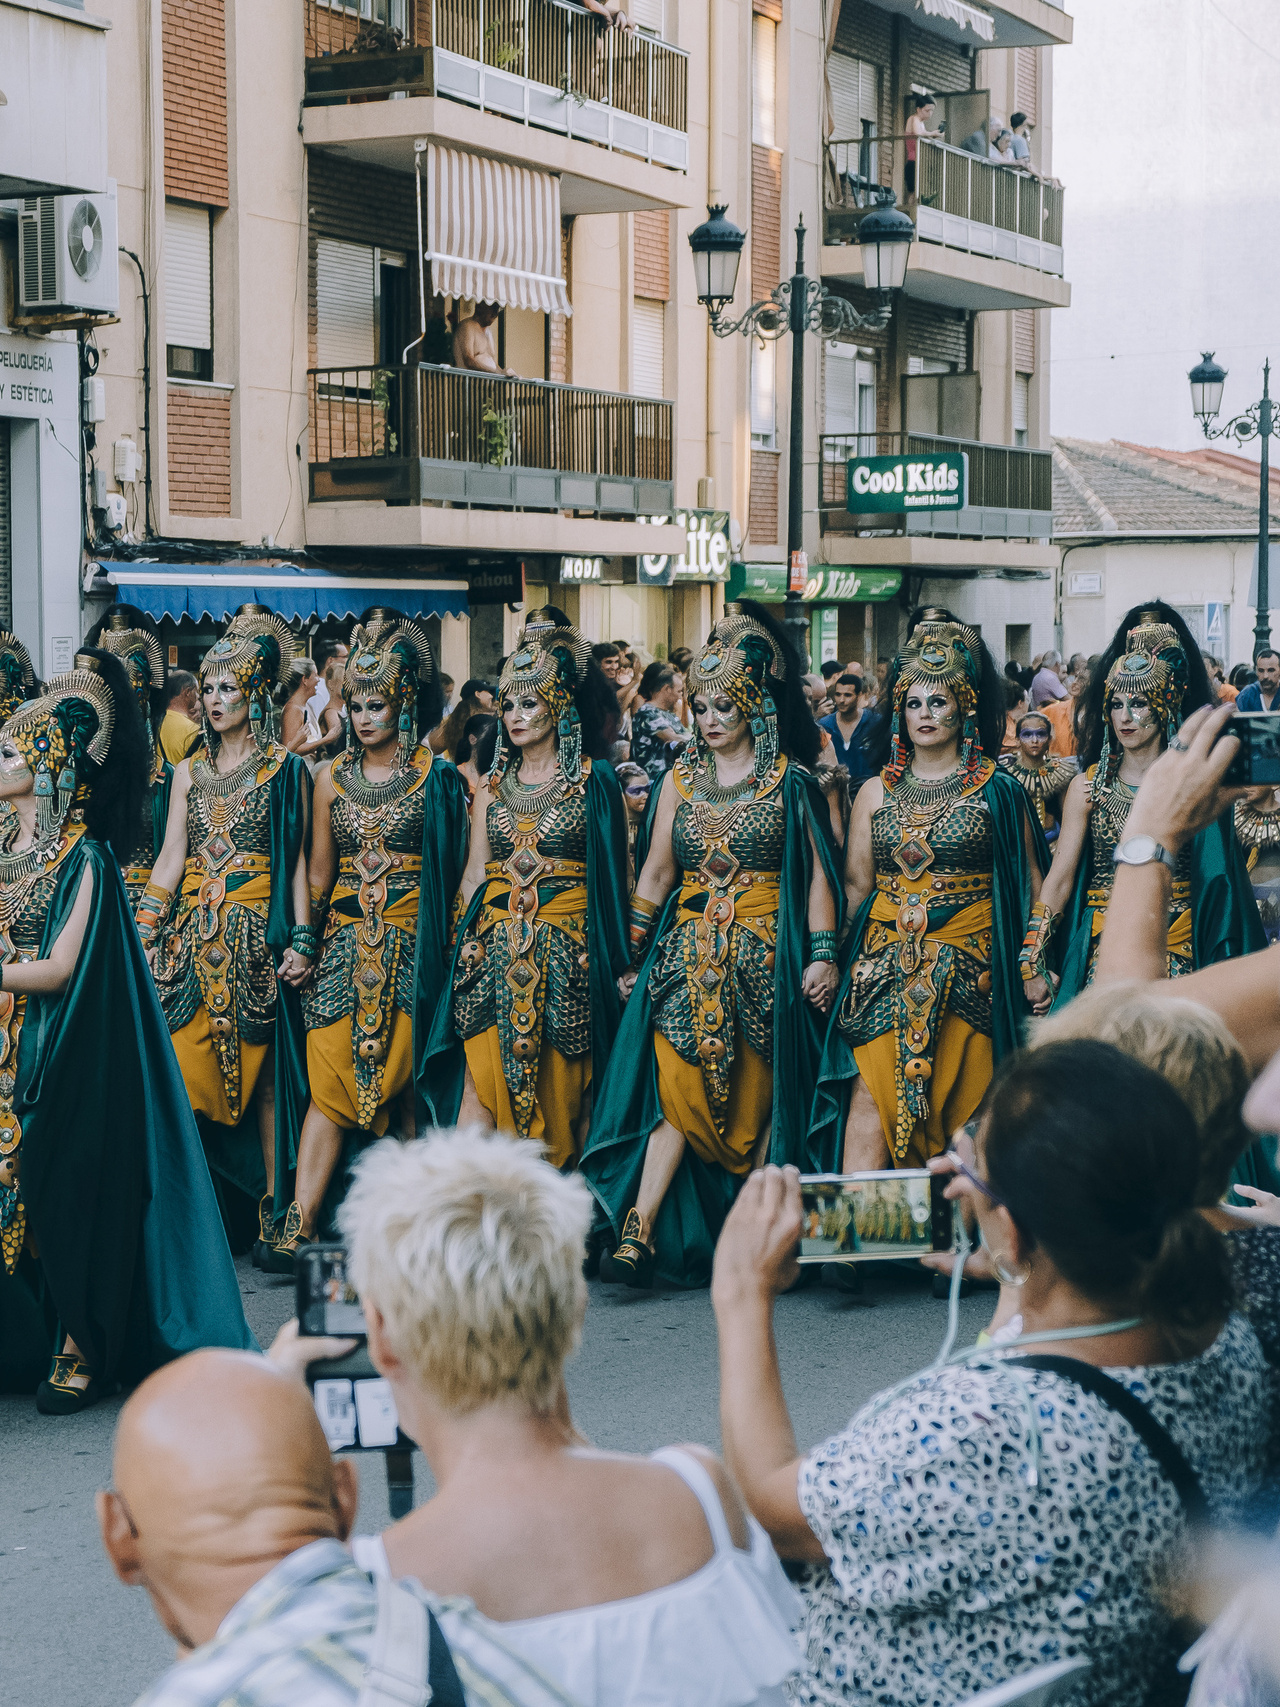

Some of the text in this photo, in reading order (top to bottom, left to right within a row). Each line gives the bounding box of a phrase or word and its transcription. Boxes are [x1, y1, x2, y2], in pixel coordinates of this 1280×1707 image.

[11, 382, 54, 404] ESTÉTICA
[852, 462, 959, 494] Cool Kids
[563, 558, 601, 579] MODA
[821, 571, 862, 599] Kids
